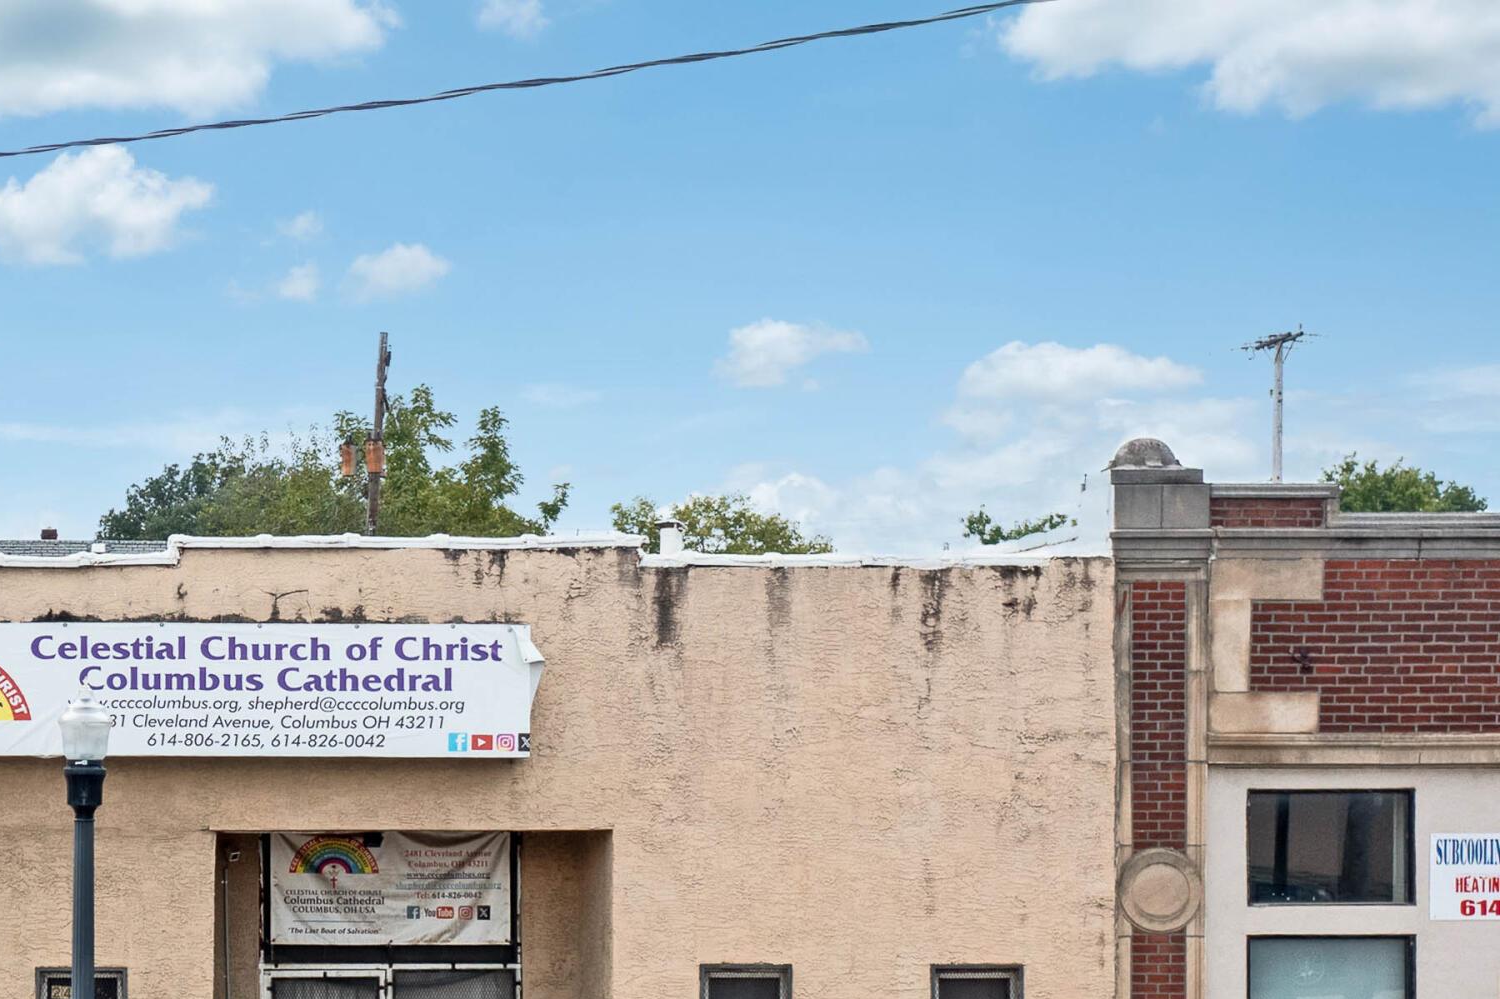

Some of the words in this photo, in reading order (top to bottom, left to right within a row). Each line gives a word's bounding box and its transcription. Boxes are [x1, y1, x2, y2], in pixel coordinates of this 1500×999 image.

[31, 635, 187, 660] Celestial
[200, 636, 331, 661] Church
[345, 636, 383, 661] of
[394, 636, 503, 662] Christ
[79, 665, 264, 691] Columbus
[277, 667, 452, 692] Cathedral
[248, 696, 465, 714] shepherd@ccccolumbus.org
[133, 714, 209, 728] Cleveland
[213, 715, 274, 730] Avenue,
[280, 715, 358, 729] Columbus
[362, 715, 391, 729] OH
[395, 716, 445, 729] 43211
[147, 733, 265, 749] 614-806-2165,
[271, 734, 386, 748] 614-826-0042
[283, 896, 334, 905] Columbus
[336, 896, 385, 906] Cathedral
[292, 906, 342, 914] COLUMBUS,
[358, 906, 376, 914] USA
